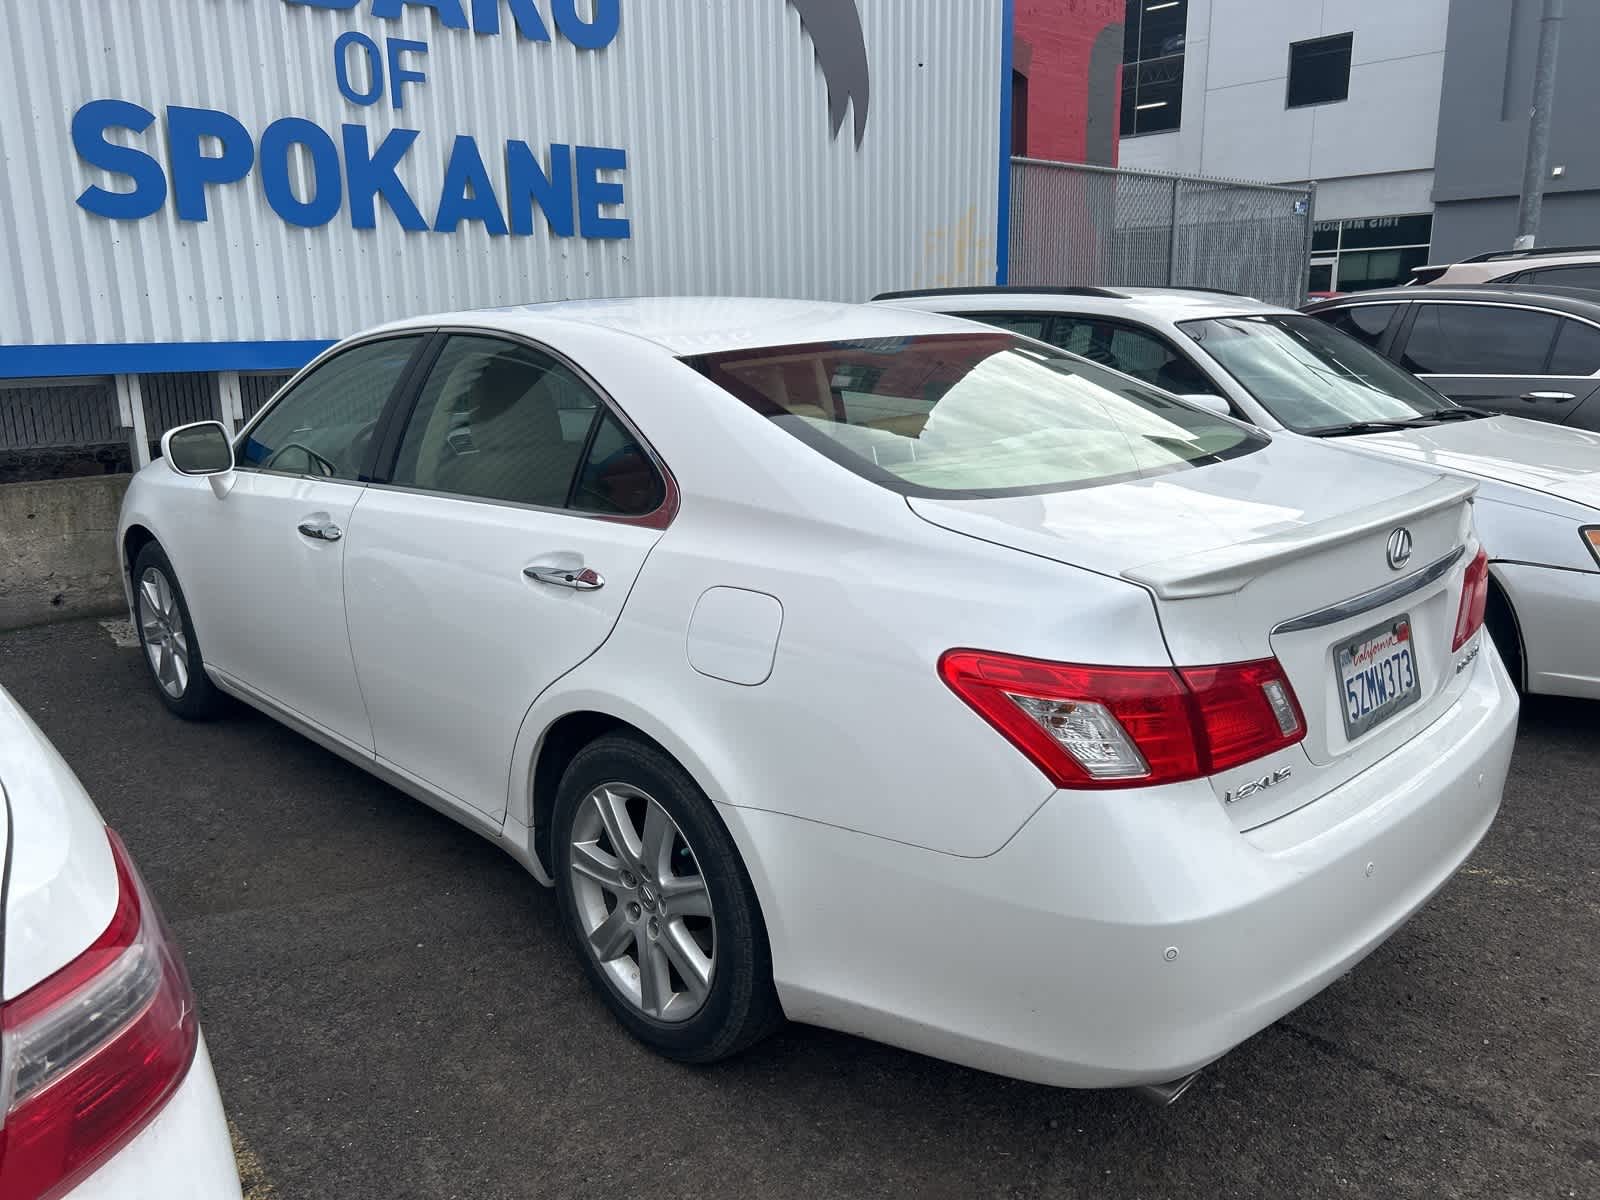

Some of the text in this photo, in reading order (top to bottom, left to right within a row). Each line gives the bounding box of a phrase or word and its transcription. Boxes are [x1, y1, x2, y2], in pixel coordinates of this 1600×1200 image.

[334, 31, 429, 109] OF
[72, 98, 631, 239] SPOKANE
[1346, 649, 1414, 720] 5ZMW373
[1353, 635, 1399, 667] California
[1224, 766, 1292, 804] LEXUS
